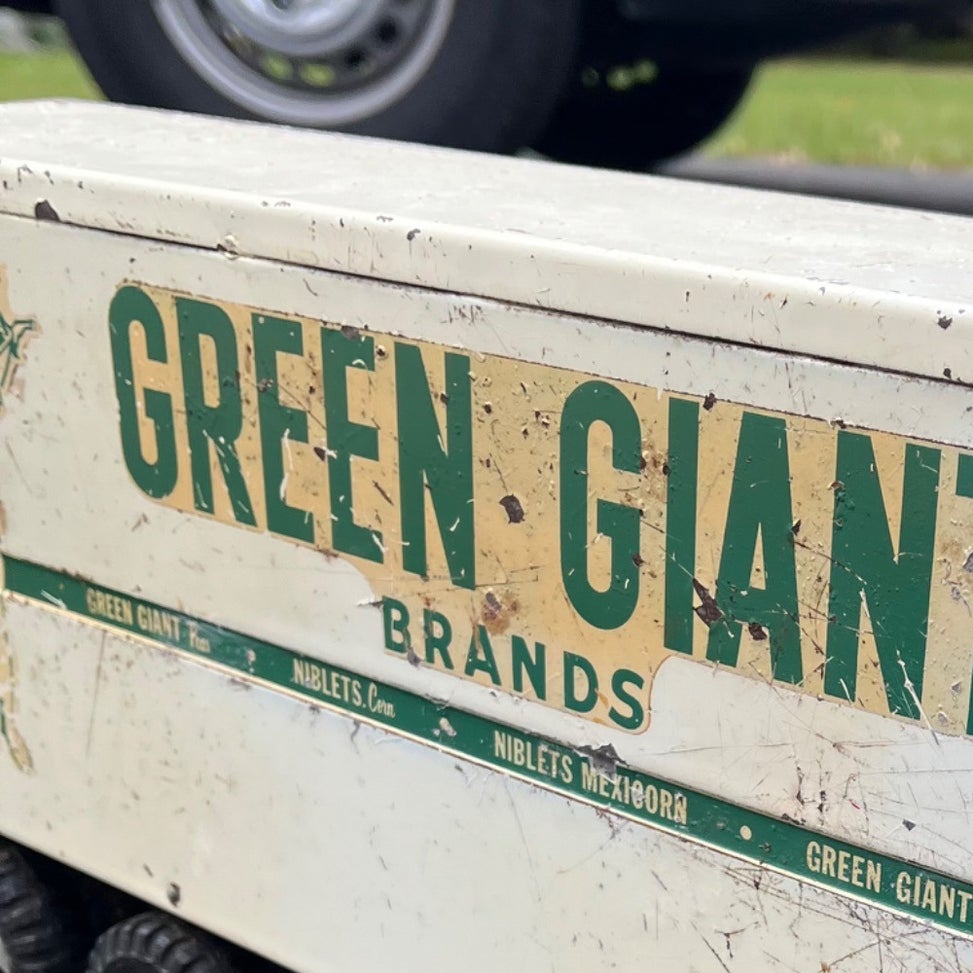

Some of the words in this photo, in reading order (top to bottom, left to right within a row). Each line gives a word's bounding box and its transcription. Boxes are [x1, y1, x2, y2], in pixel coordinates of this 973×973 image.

[108, 285, 475, 590] GREEN
[86, 587, 133, 626] GREEN
[137, 604, 180, 642] GIANT
[368, 682, 396, 718] Corn
[381, 595, 645, 730] BRANDS
[493, 730, 574, 784] NIBLETS
[581, 762, 687, 825] MEXICORN
[806, 841, 882, 893] GREEN
[896, 871, 973, 923] GIANT
